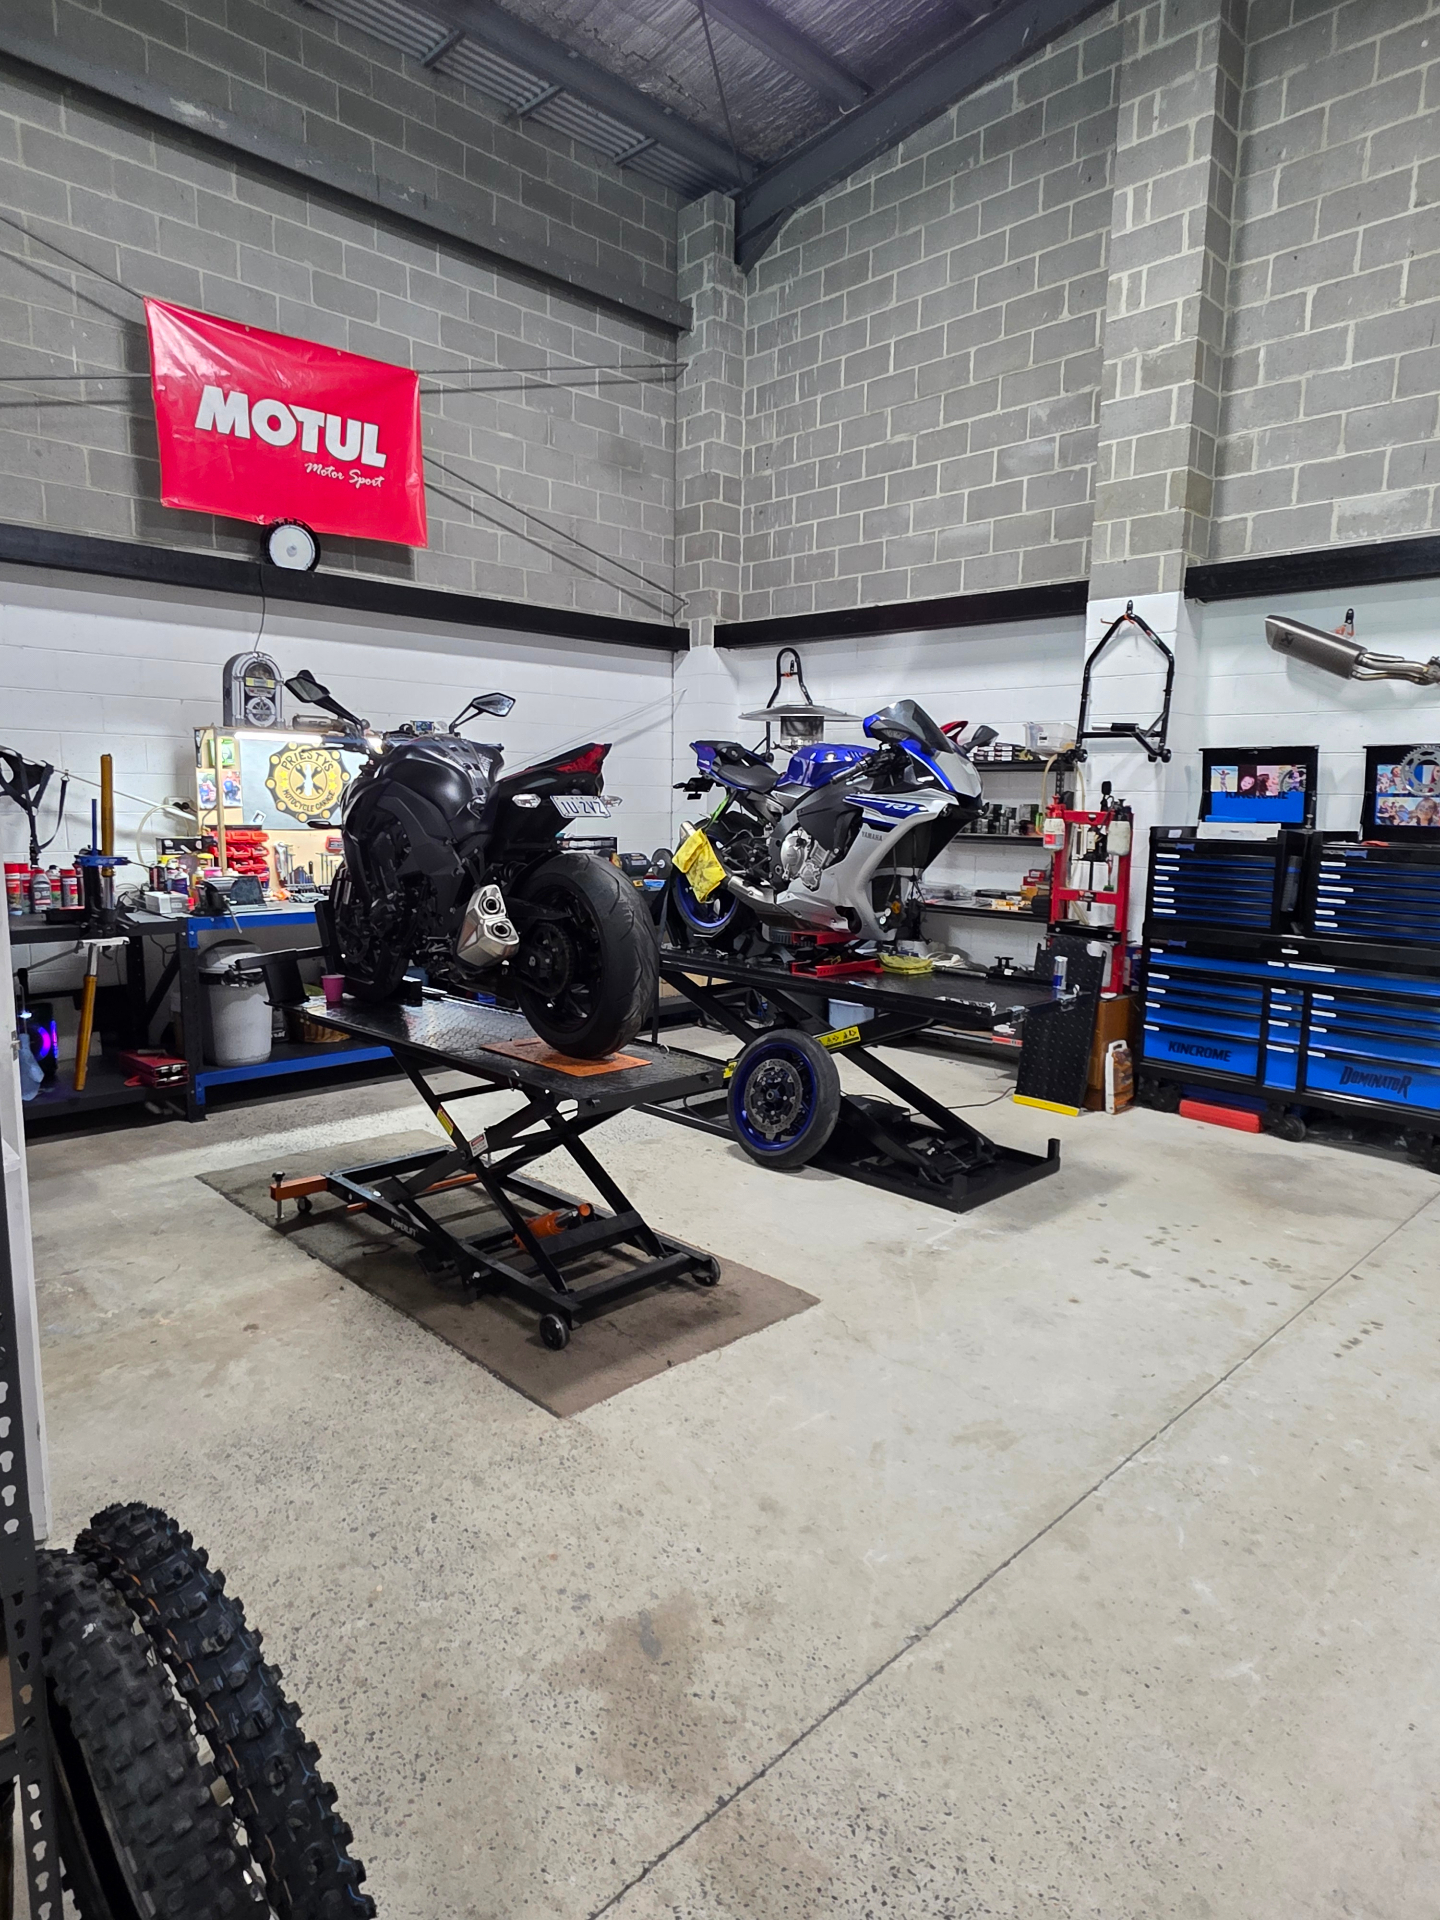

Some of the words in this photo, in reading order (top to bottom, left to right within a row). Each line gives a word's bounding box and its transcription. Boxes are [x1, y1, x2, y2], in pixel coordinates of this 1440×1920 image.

[194, 384, 387, 468] MOTUL
[304, 462, 345, 480] Motor
[348, 469, 385, 489] Sport
[315, 790, 335, 810] GARAGE
[862, 831, 883, 841] YAMAHA
[1168, 1041, 1232, 1062] KINCROME
[1339, 1066, 1412, 1099] DOMINATOR
